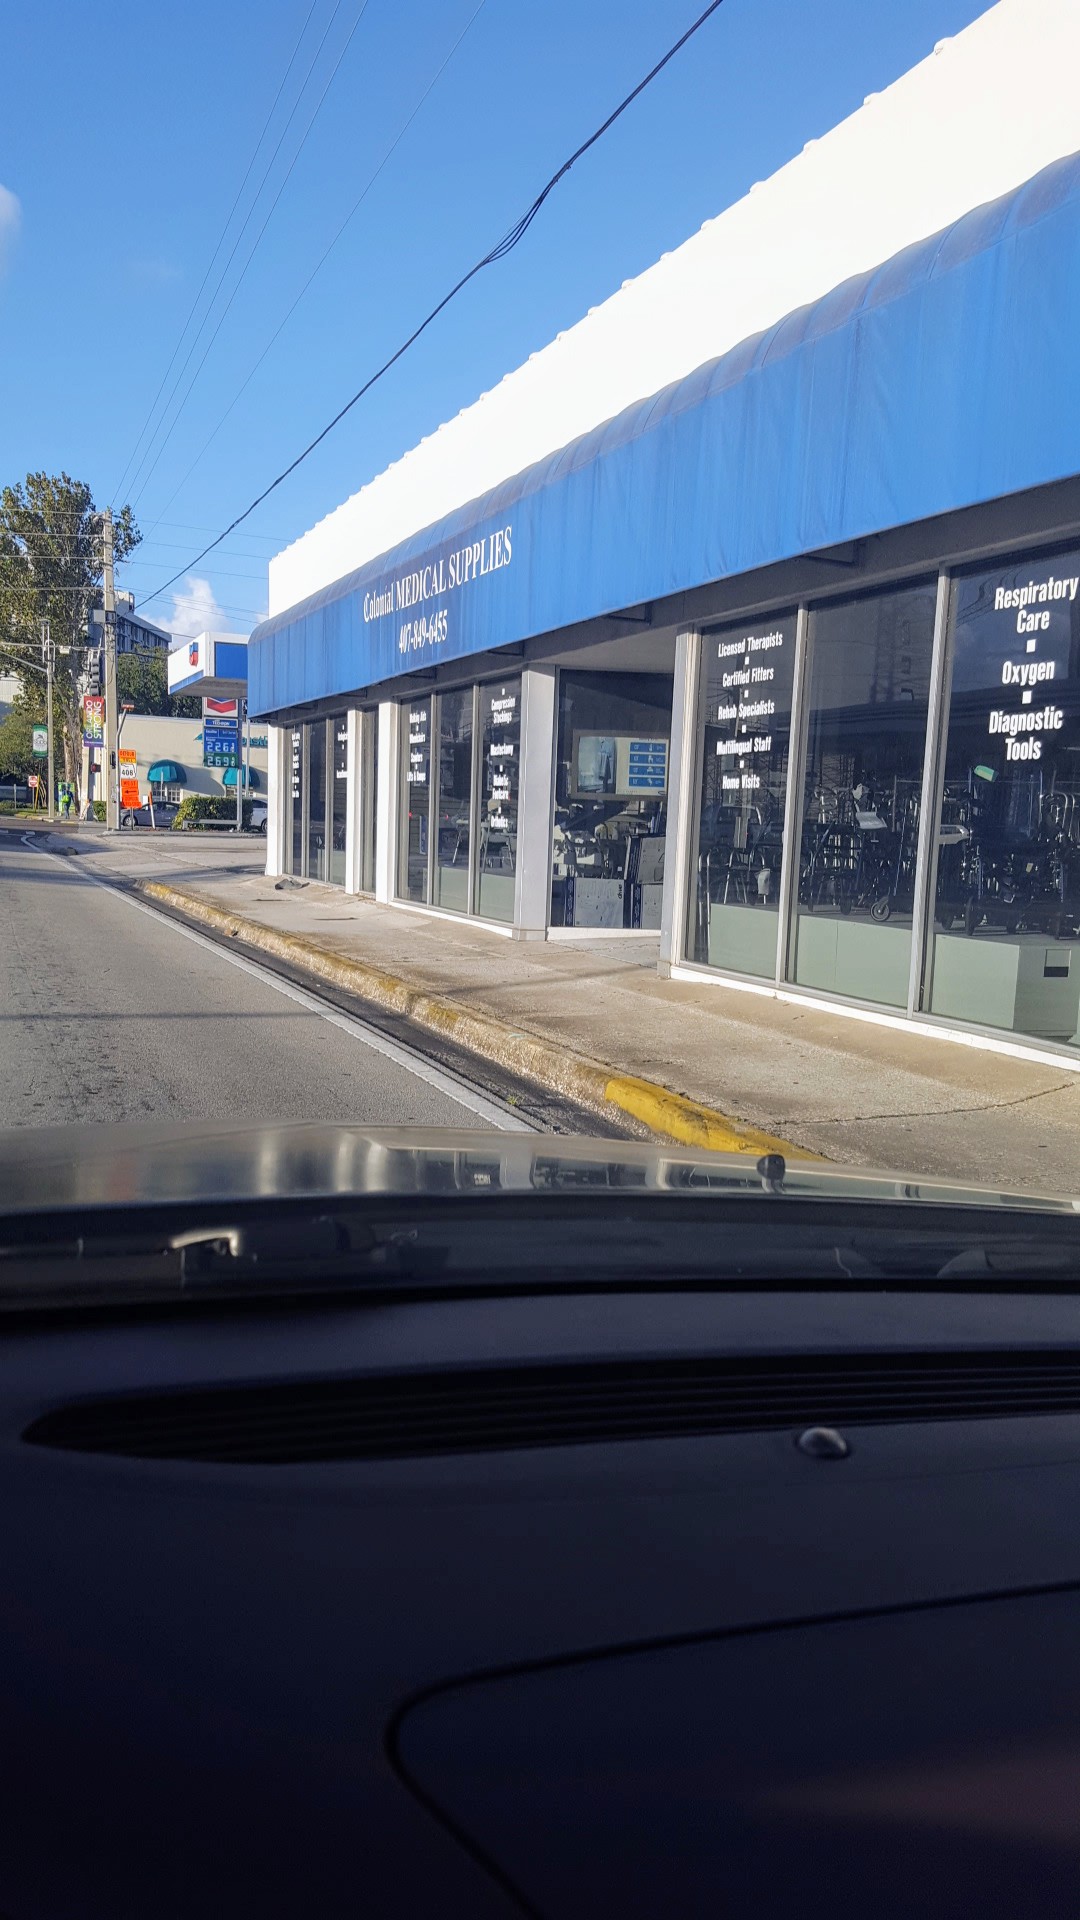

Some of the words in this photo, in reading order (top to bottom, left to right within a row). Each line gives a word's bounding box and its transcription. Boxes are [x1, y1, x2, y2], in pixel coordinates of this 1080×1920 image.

[363, 580, 394, 623] Colonial
[396, 559, 447, 611] MEDICAL
[448, 525, 513, 589] SUPPLIES
[995, 576, 1079, 610] Respiratory
[398, 609, 449, 654] 407-849-6455
[1016, 610, 1050, 634] Care
[718, 638, 746, 658] Licensed
[747, 631, 783, 651] Therapists
[722, 669, 750, 687] Certified
[752, 667, 775, 683] Fitters
[1002, 660, 1056, 686] Oxygen
[94, 701, 102, 739] STRONG
[718, 704, 737, 720] Rehab
[739, 699, 775, 719] Specialists
[989, 706, 1064, 736] Diagnostic
[716, 739, 752, 756] Multilingual
[754, 736, 772, 752] Staff
[1005, 737, 1042, 761] Tools
[722, 776, 740, 790] Home
[741, 774, 760, 789] Visits
